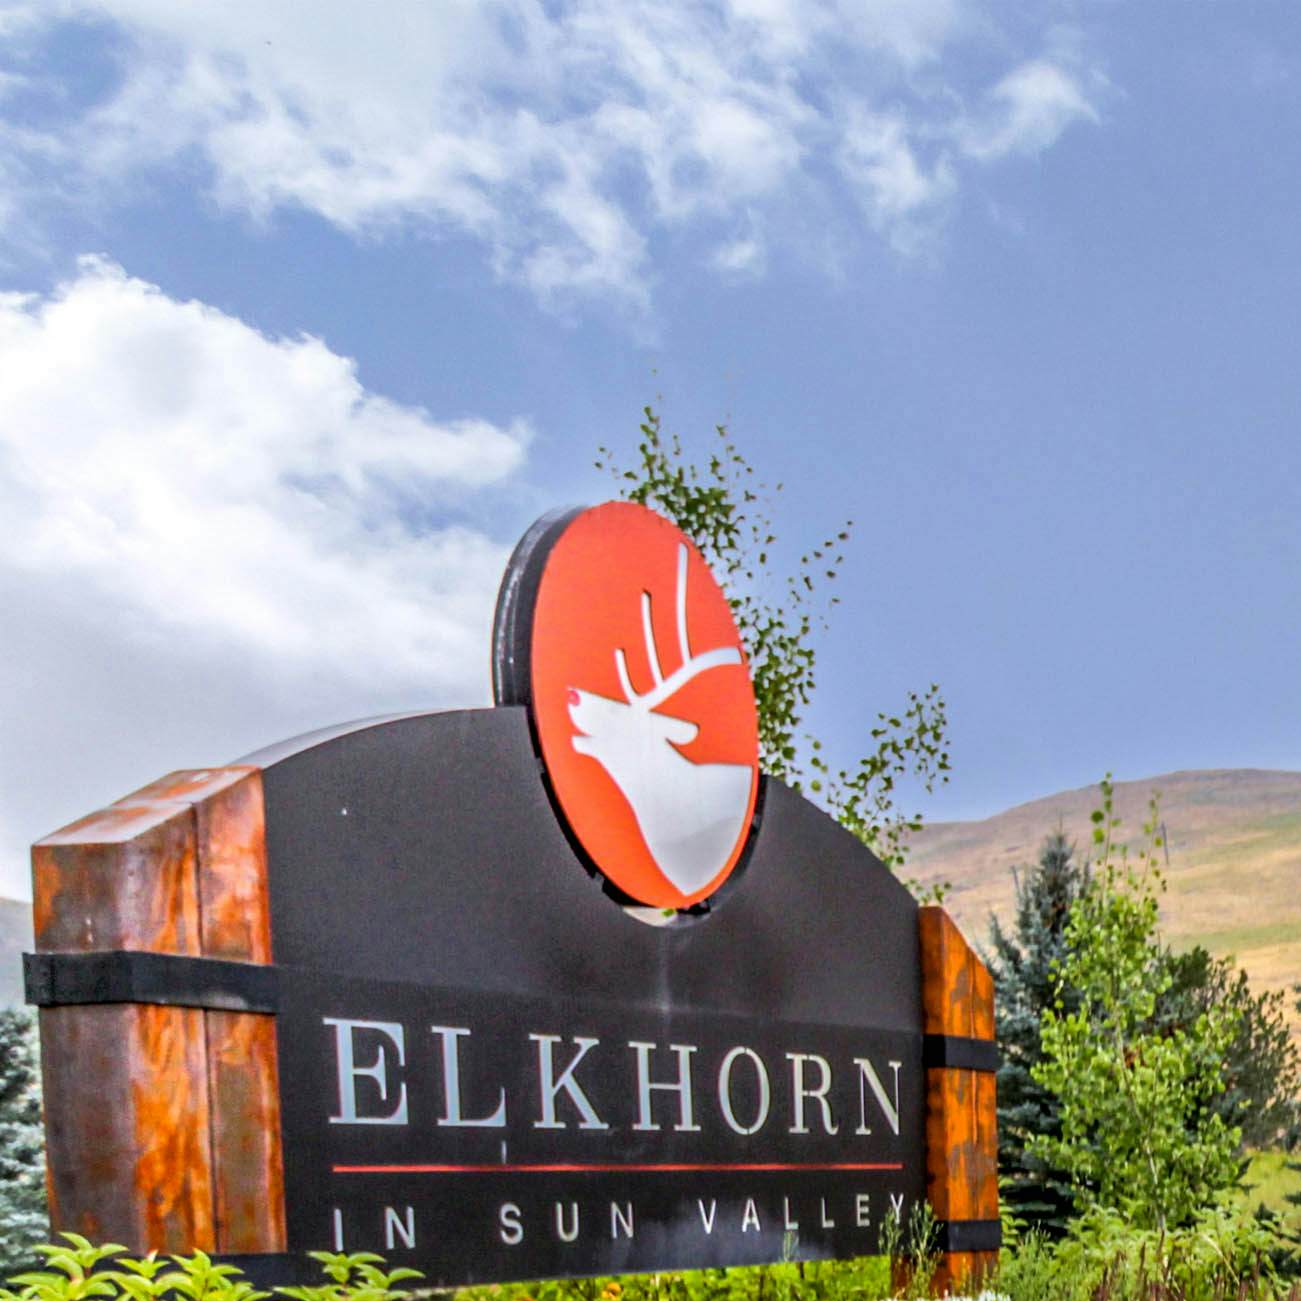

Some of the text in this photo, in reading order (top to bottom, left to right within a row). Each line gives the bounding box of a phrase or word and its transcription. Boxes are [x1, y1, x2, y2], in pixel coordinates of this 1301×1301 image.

[323, 1016, 903, 1137] ELKHORN
[333, 1192, 904, 1250] IN SUN VALLEY
